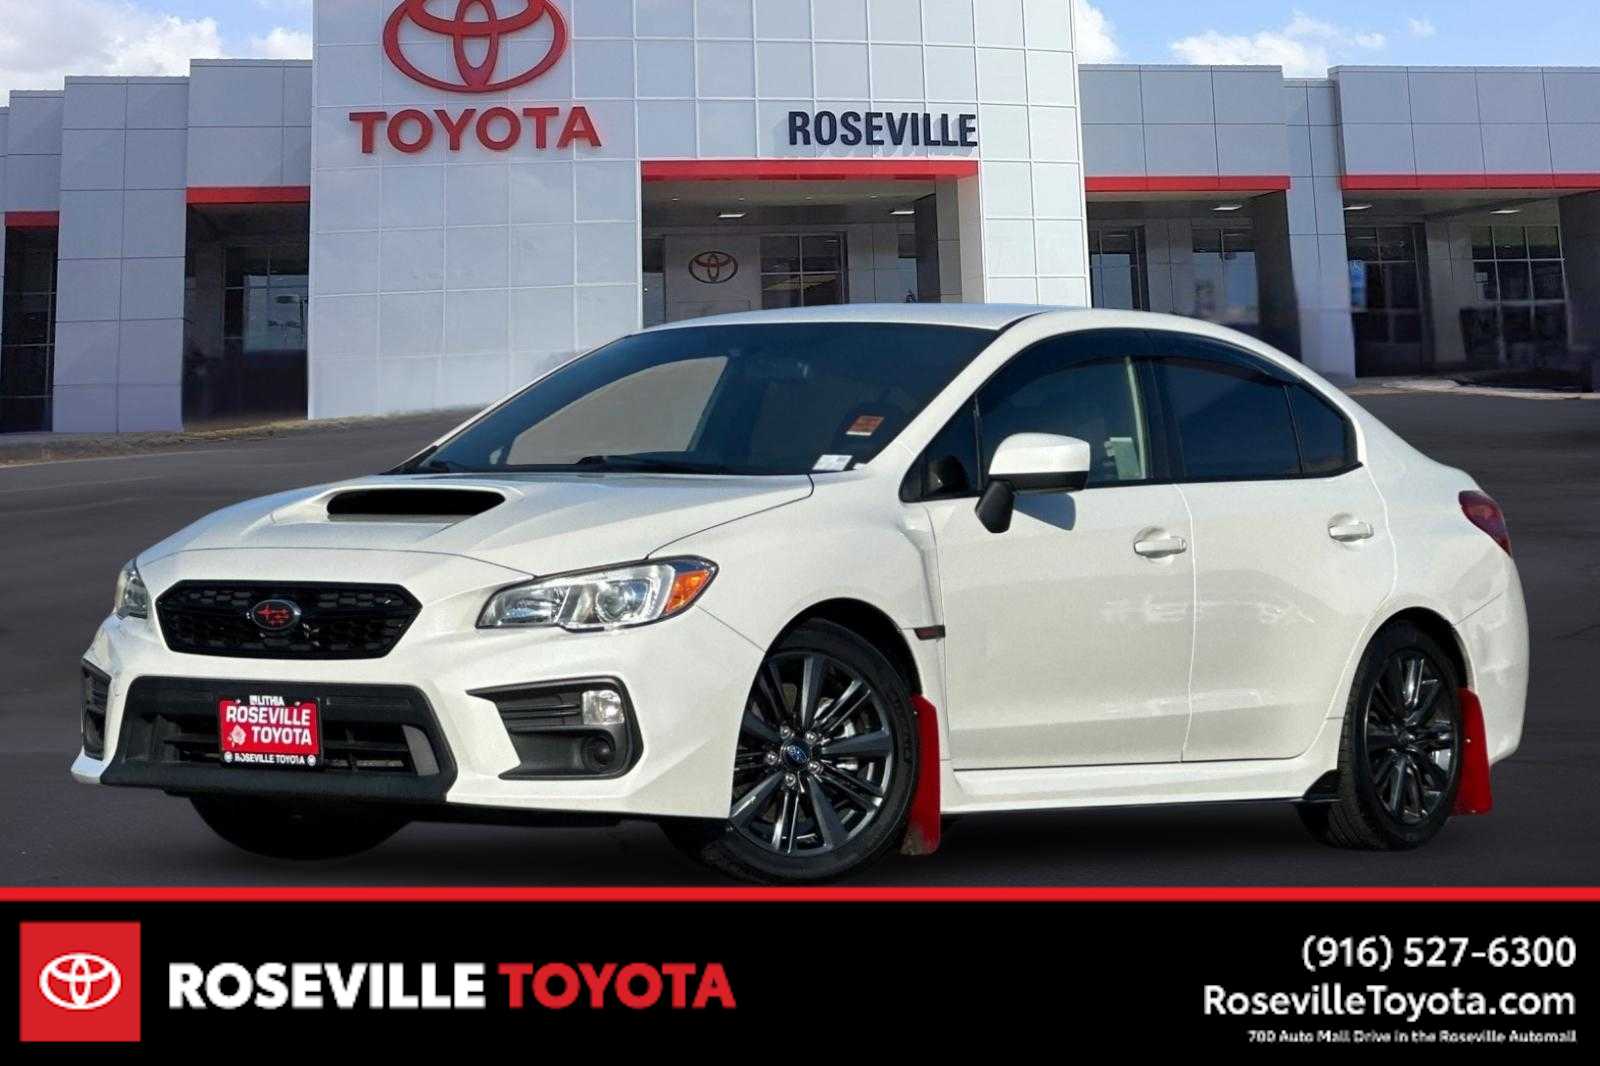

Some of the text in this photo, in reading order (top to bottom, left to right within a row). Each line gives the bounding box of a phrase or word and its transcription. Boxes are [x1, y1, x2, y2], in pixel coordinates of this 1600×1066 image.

[349, 106, 602, 154] TOYOTA
[788, 111, 978, 147] ROSEVILLE
[226, 706, 311, 726] ROSEVILLE
[251, 725, 312, 746] TOYOTA
[234, 752, 306, 765] ROSEVILLE TOYOTA
